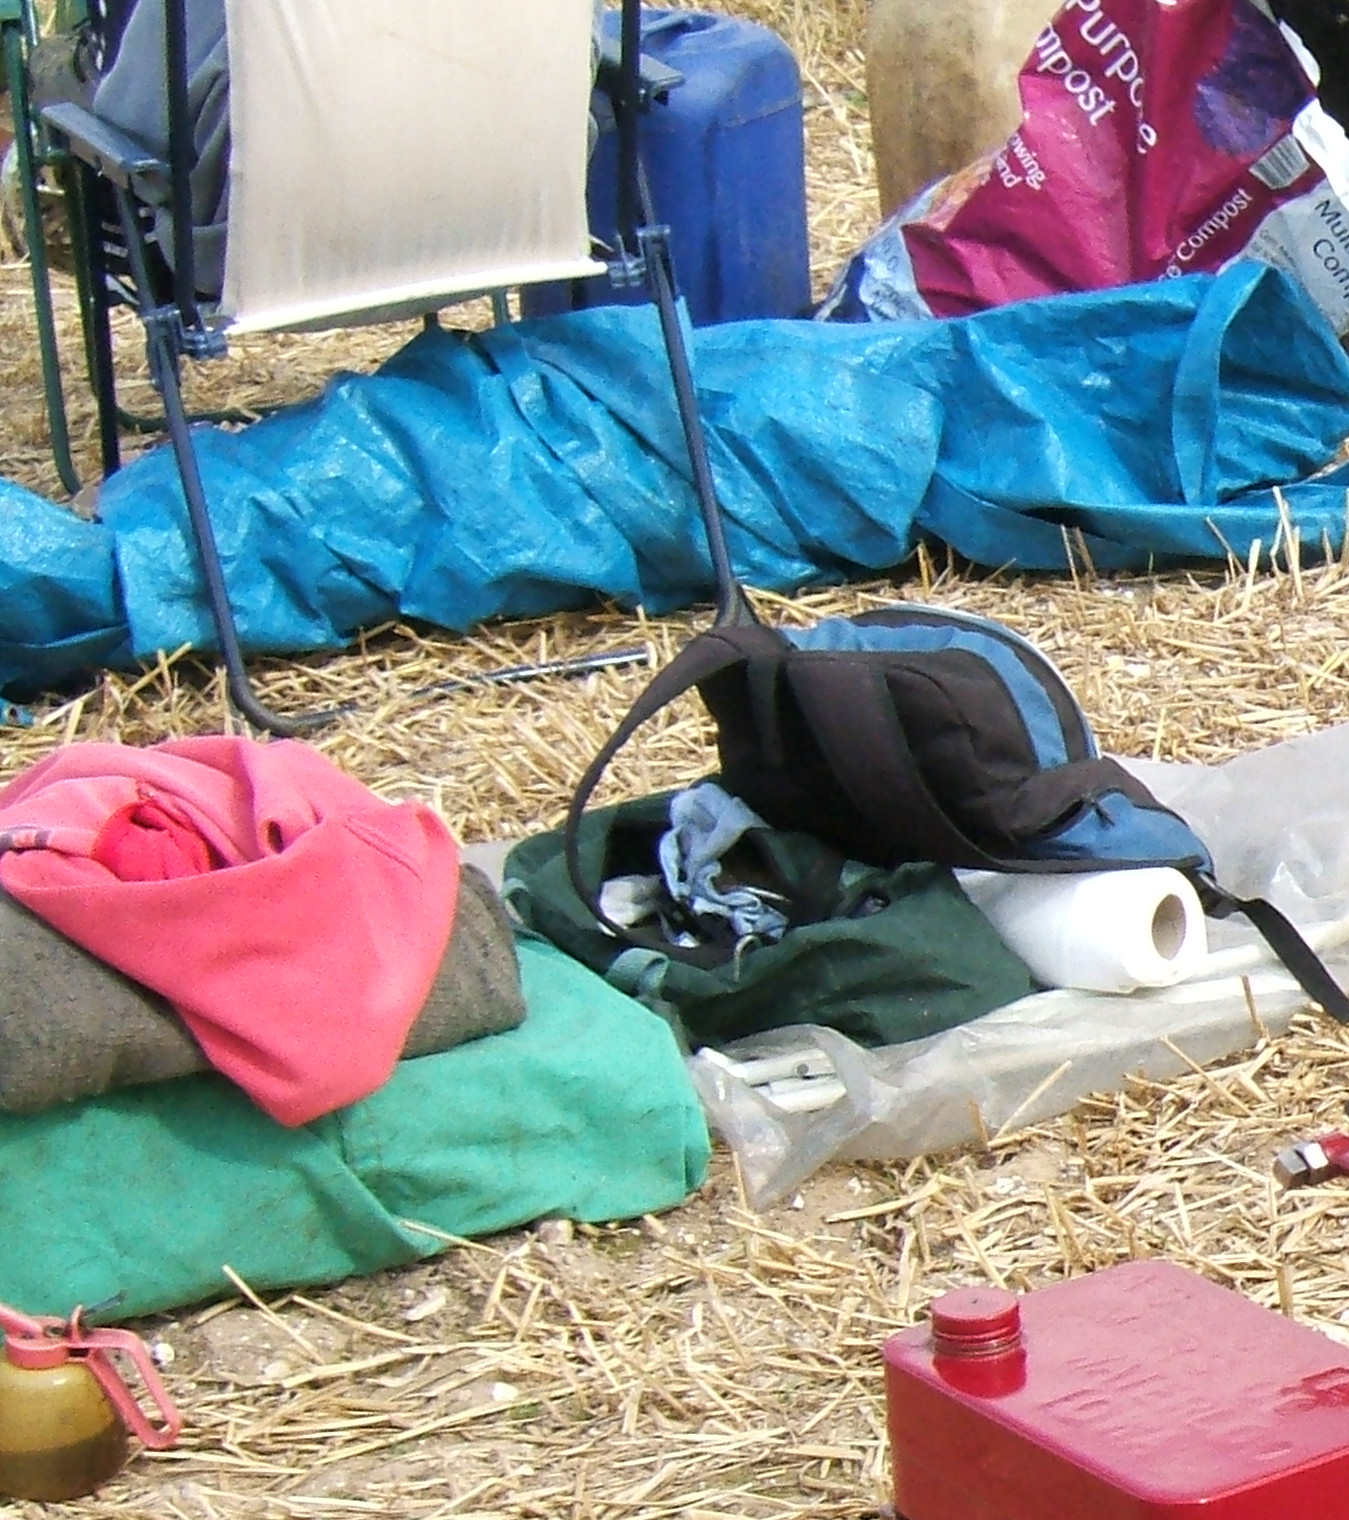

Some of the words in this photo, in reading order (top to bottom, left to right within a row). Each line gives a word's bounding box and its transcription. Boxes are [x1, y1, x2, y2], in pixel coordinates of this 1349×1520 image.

[1036, 26, 1117, 127] mpost
[1064, 0, 1158, 155] Purpoe
[1176, 187, 1254, 261] Compost
